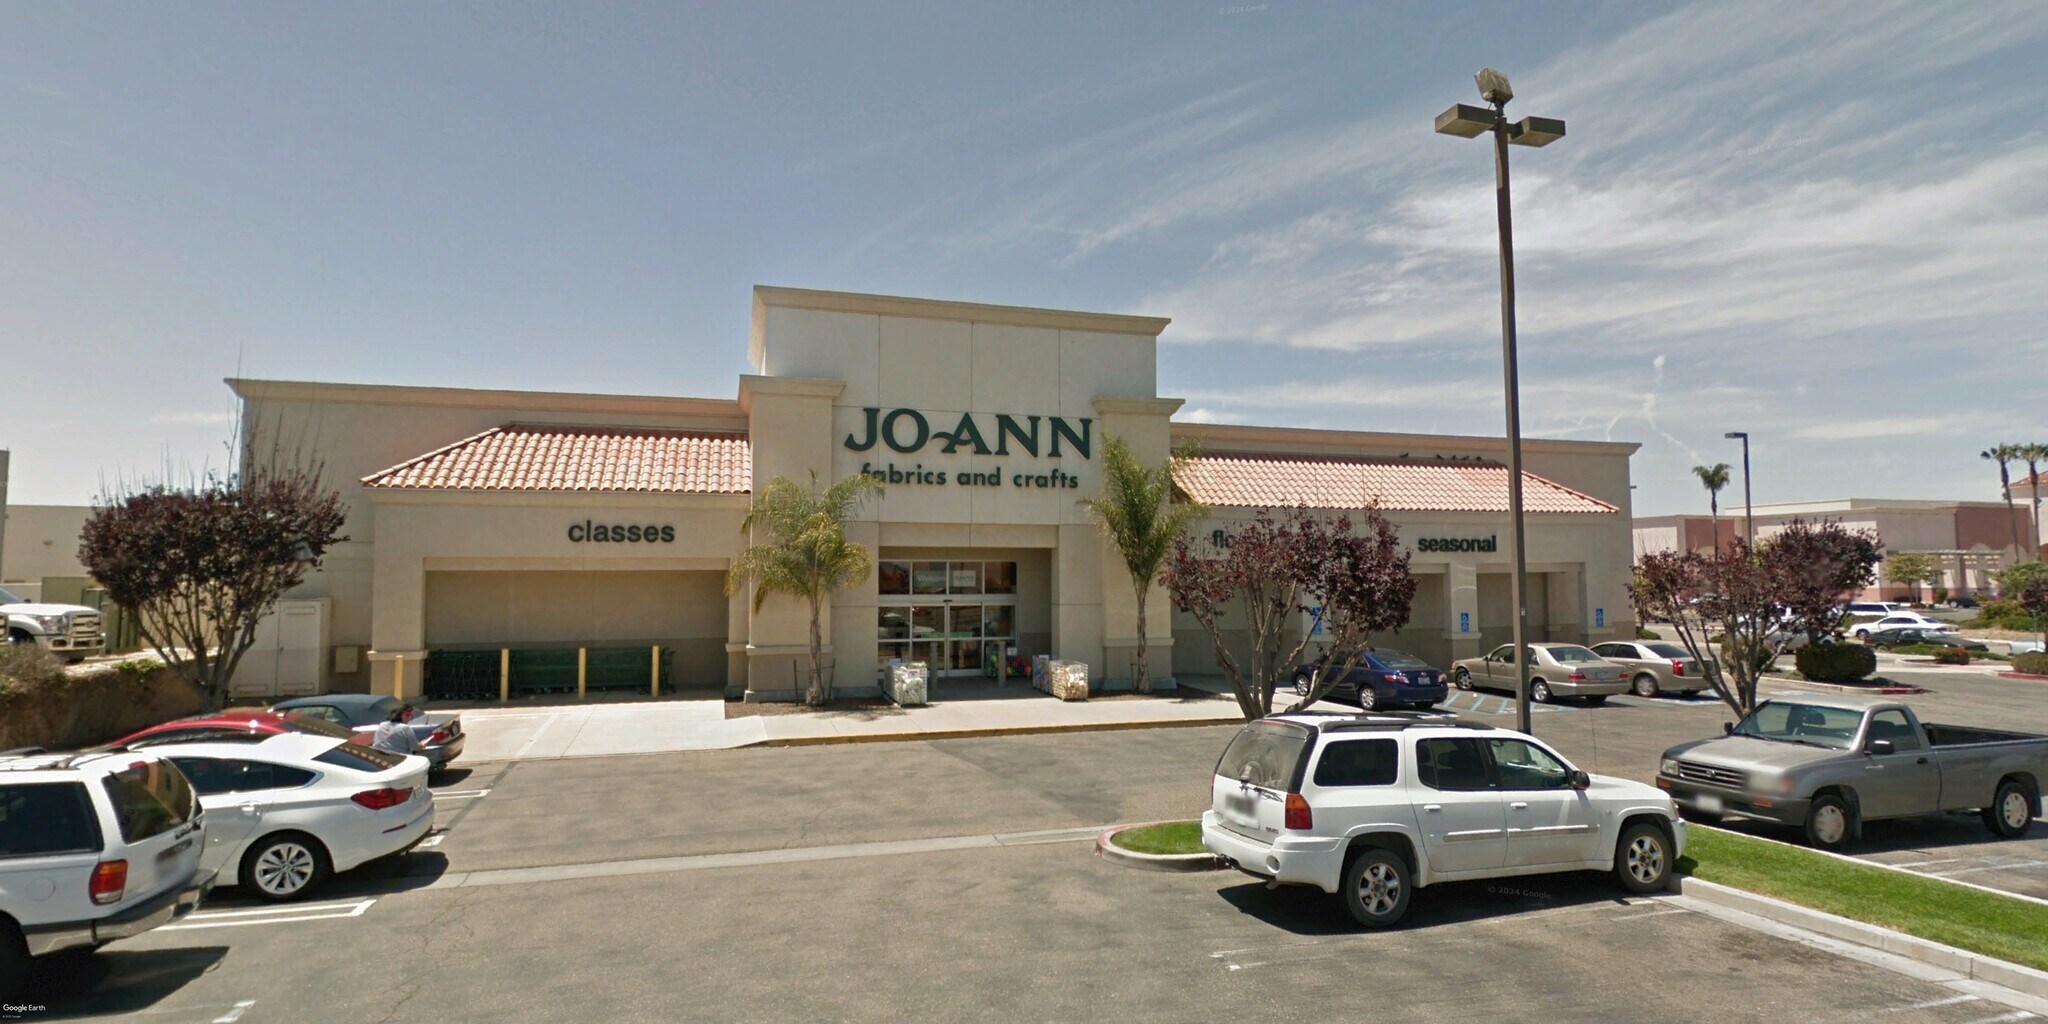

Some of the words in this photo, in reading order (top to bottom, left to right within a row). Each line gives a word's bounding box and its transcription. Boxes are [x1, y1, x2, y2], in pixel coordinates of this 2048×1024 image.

[957, 466, 1001, 487] and
[1013, 468, 1079, 489] crafts
[567, 519, 675, 543] classes
[1418, 534, 1497, 553] seasonal
